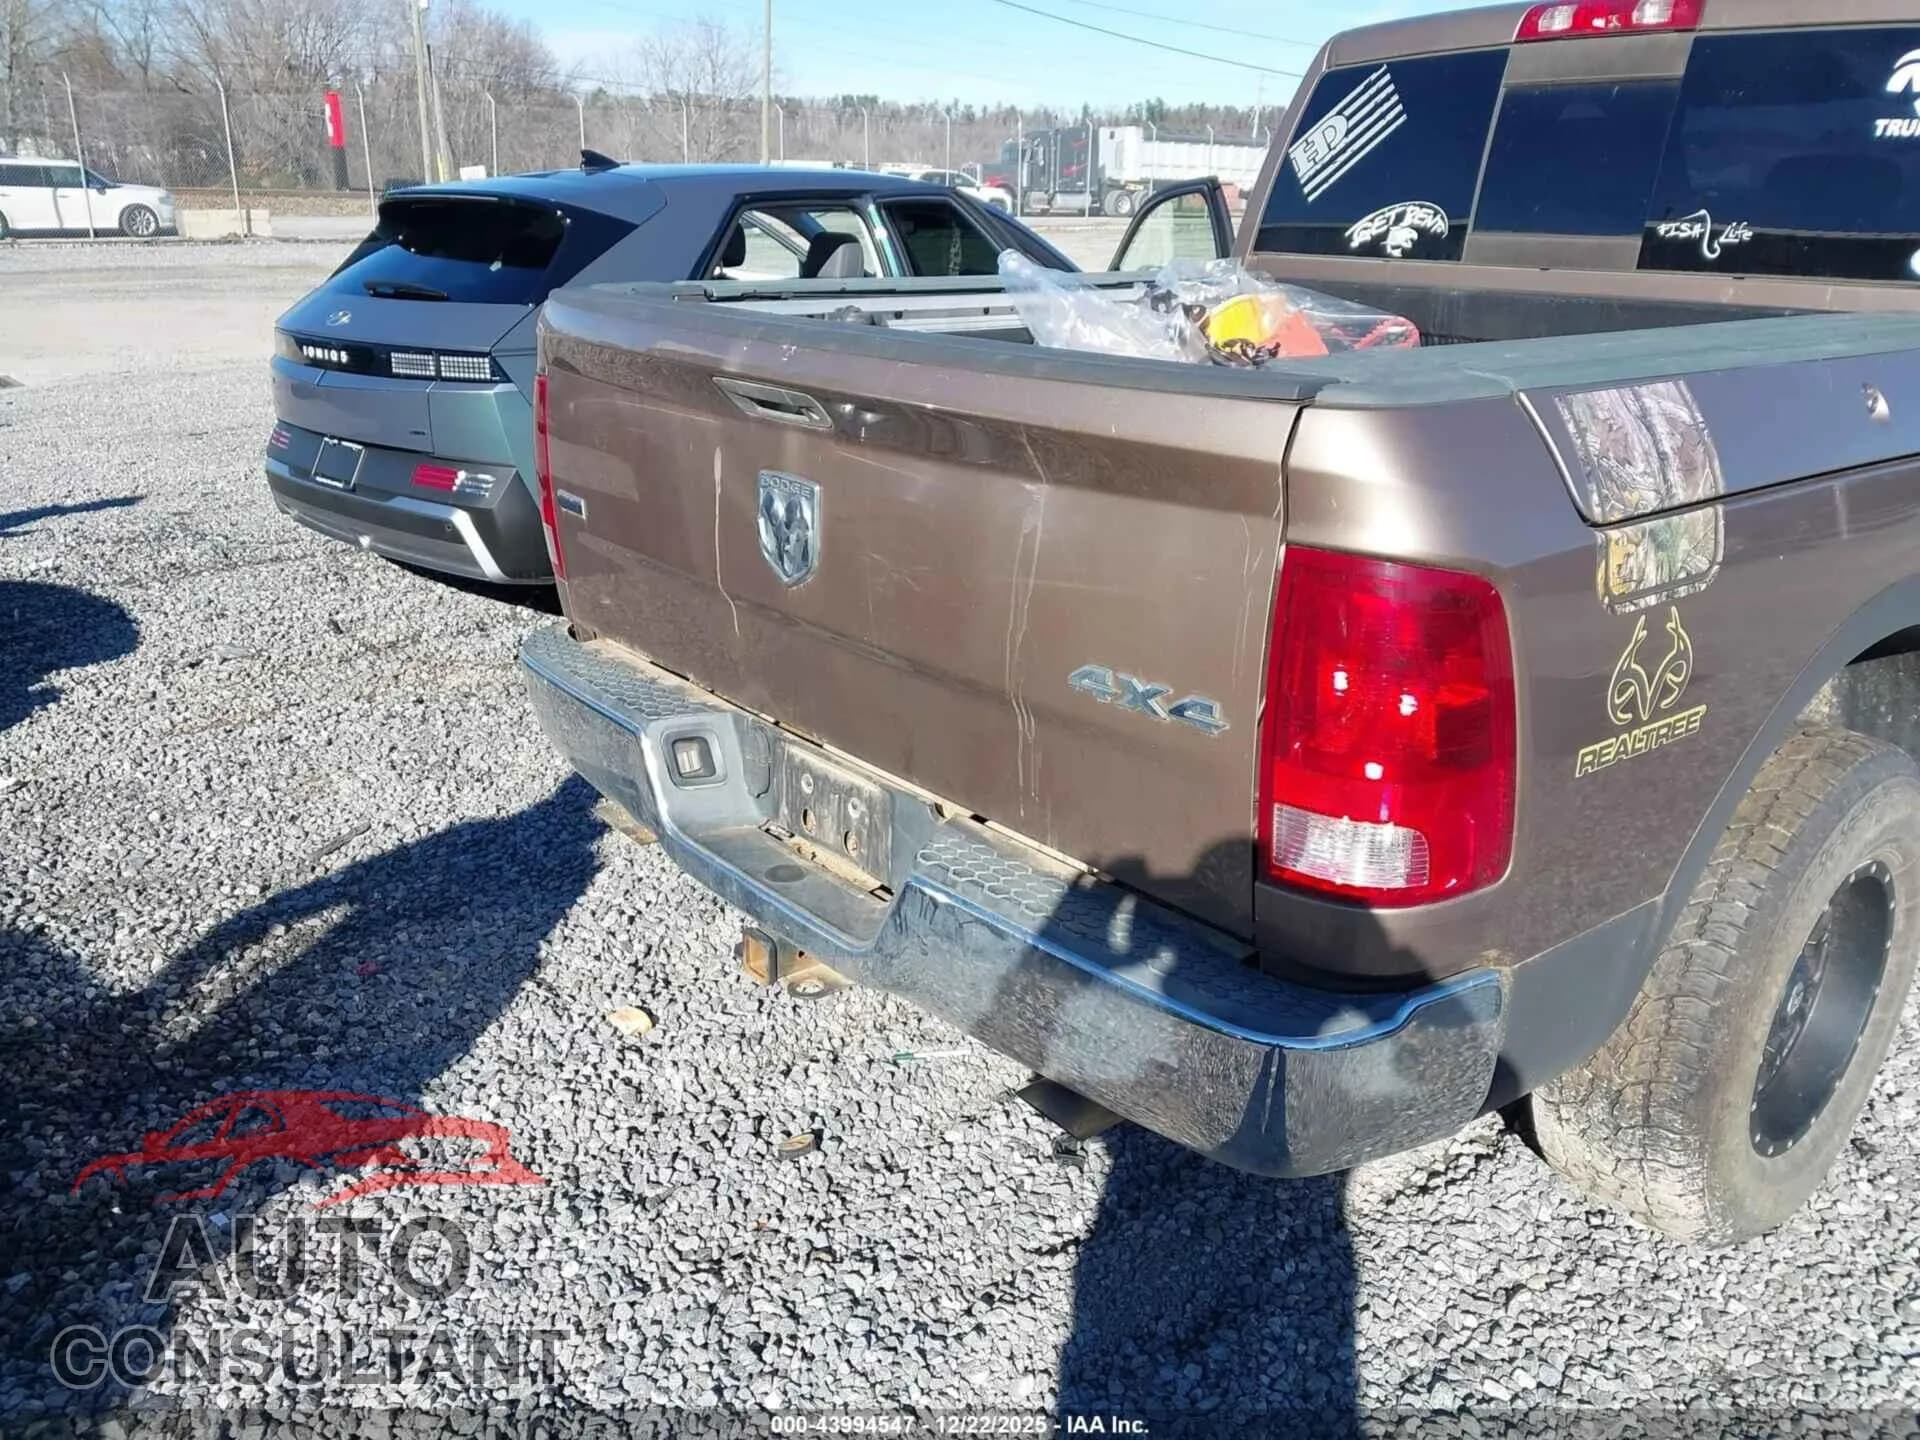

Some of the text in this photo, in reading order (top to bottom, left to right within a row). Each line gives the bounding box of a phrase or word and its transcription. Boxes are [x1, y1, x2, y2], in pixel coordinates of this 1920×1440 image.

[1874, 118, 1920, 137] TRU
[1350, 206, 1407, 248] GET
[1657, 222, 1704, 238] FISH
[760, 472, 813, 500] DODGE
[1575, 704, 1707, 778] REALTREE
